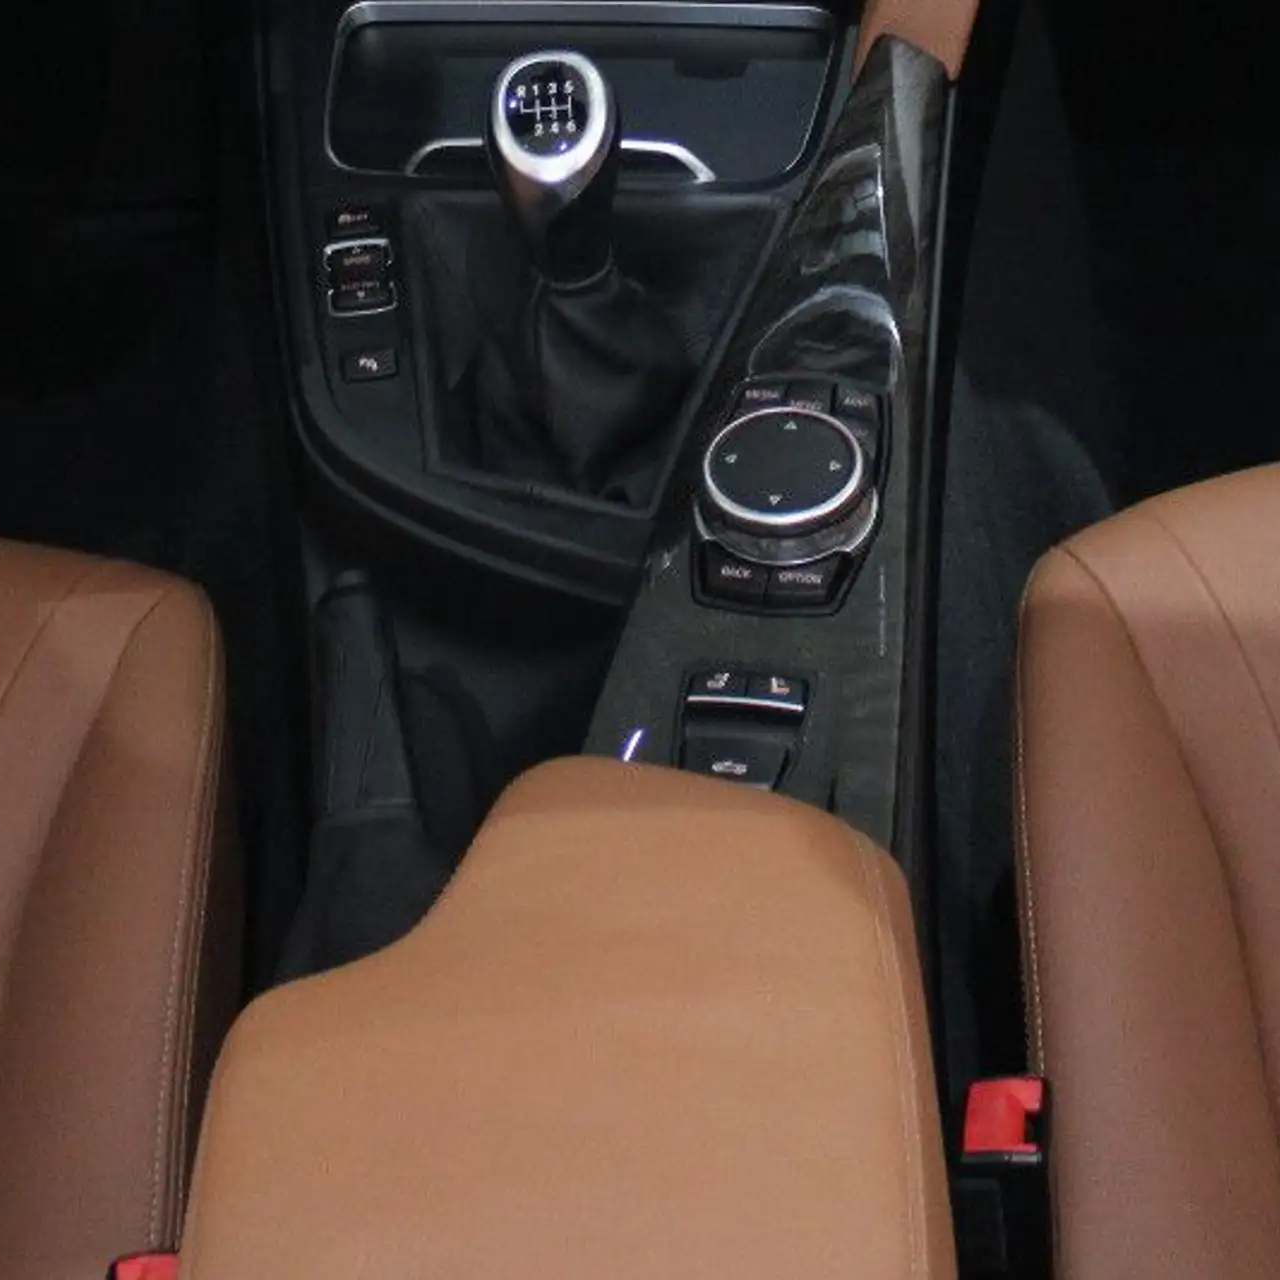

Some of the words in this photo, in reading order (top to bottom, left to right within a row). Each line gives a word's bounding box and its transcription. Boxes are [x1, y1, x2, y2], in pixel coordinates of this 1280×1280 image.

[516, 85, 526, 98] R
[532, 84, 539, 96] 1
[547, 82, 557, 94] 3
[564, 80, 574, 93] 5
[534, 123, 544, 137] 2
[550, 121, 559, 133] 4
[566, 120, 576, 133] 6
[721, 565, 753, 579] BACK
[777, 571, 823, 584] OPTION
